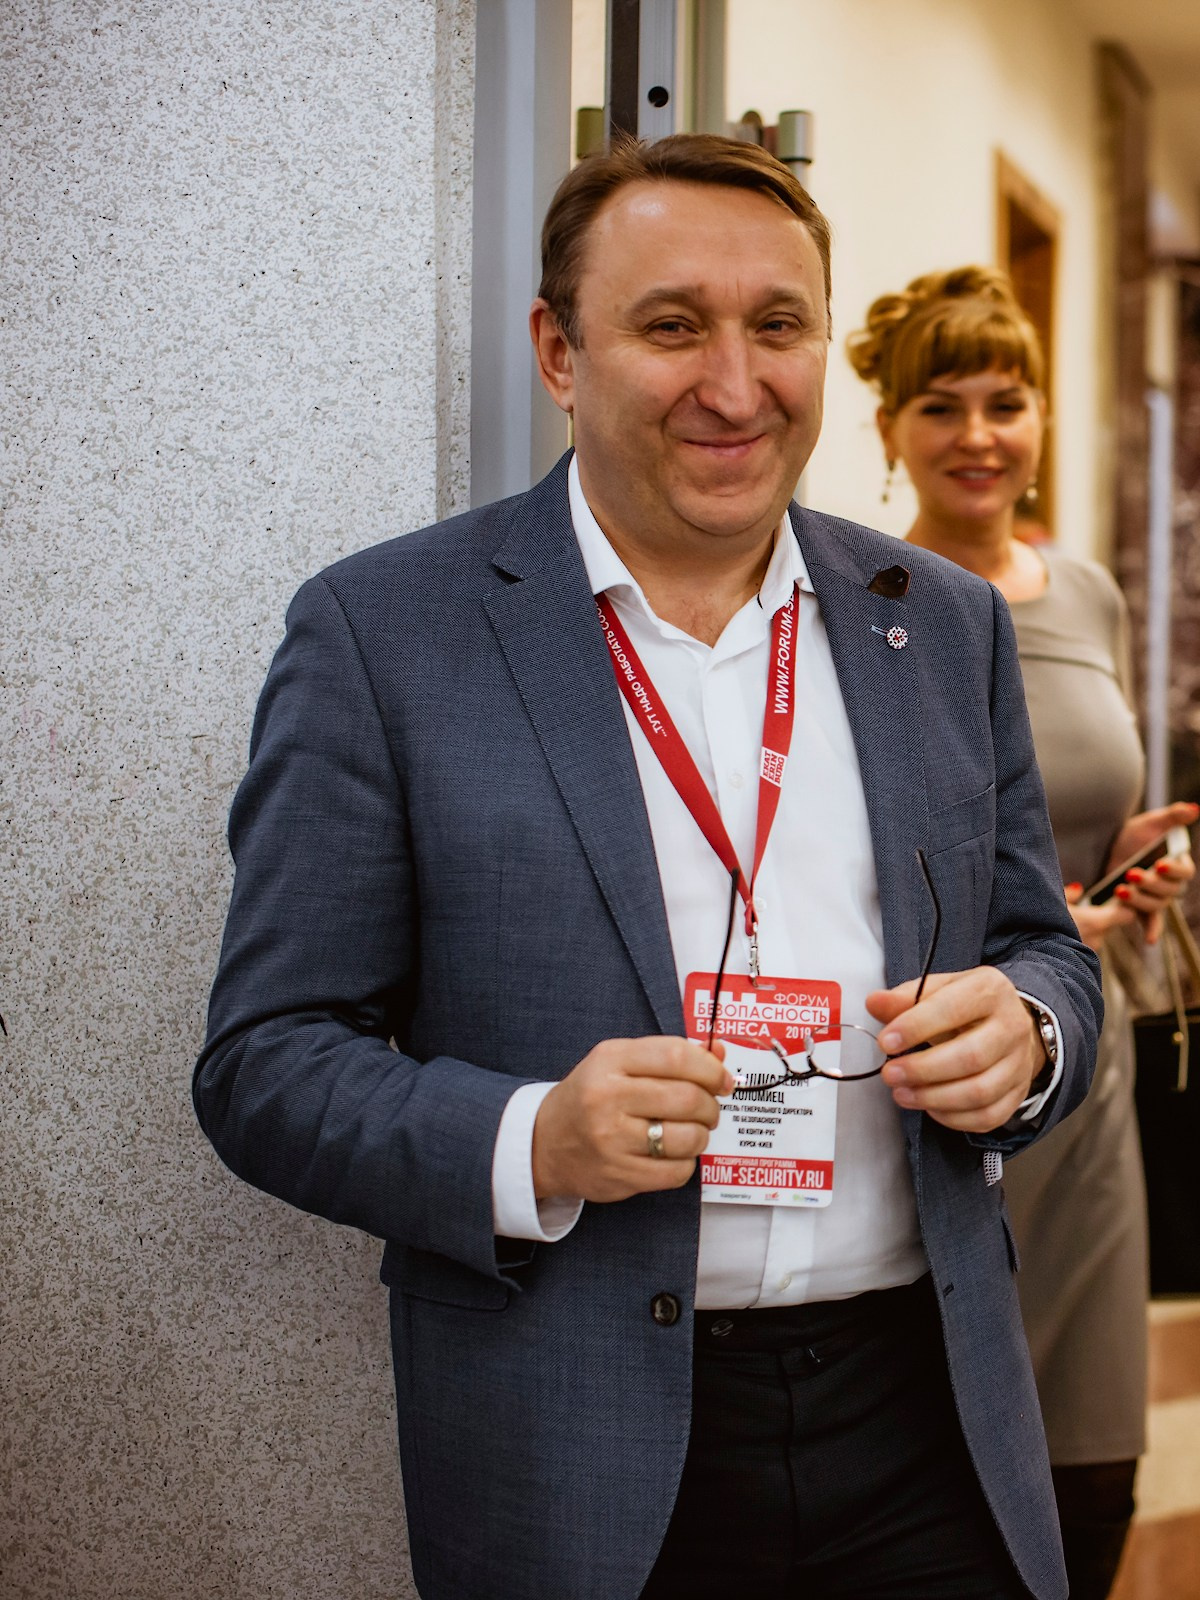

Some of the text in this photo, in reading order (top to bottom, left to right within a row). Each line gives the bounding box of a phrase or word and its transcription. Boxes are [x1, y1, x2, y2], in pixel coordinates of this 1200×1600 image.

[606, 630, 637, 682] РАБОТАТЬ
[631, 682, 653, 713] НАДО
[774, 993, 829, 1007] ФОРУМ
[698, 1002, 827, 1023] БЕЗОПАСНОСТЬ
[696, 1019, 770, 1037] БИЗНЕСА
[785, 1026, 812, 1039] 2019
[782, 1107, 813, 1116] ДИРЕКТОРА
